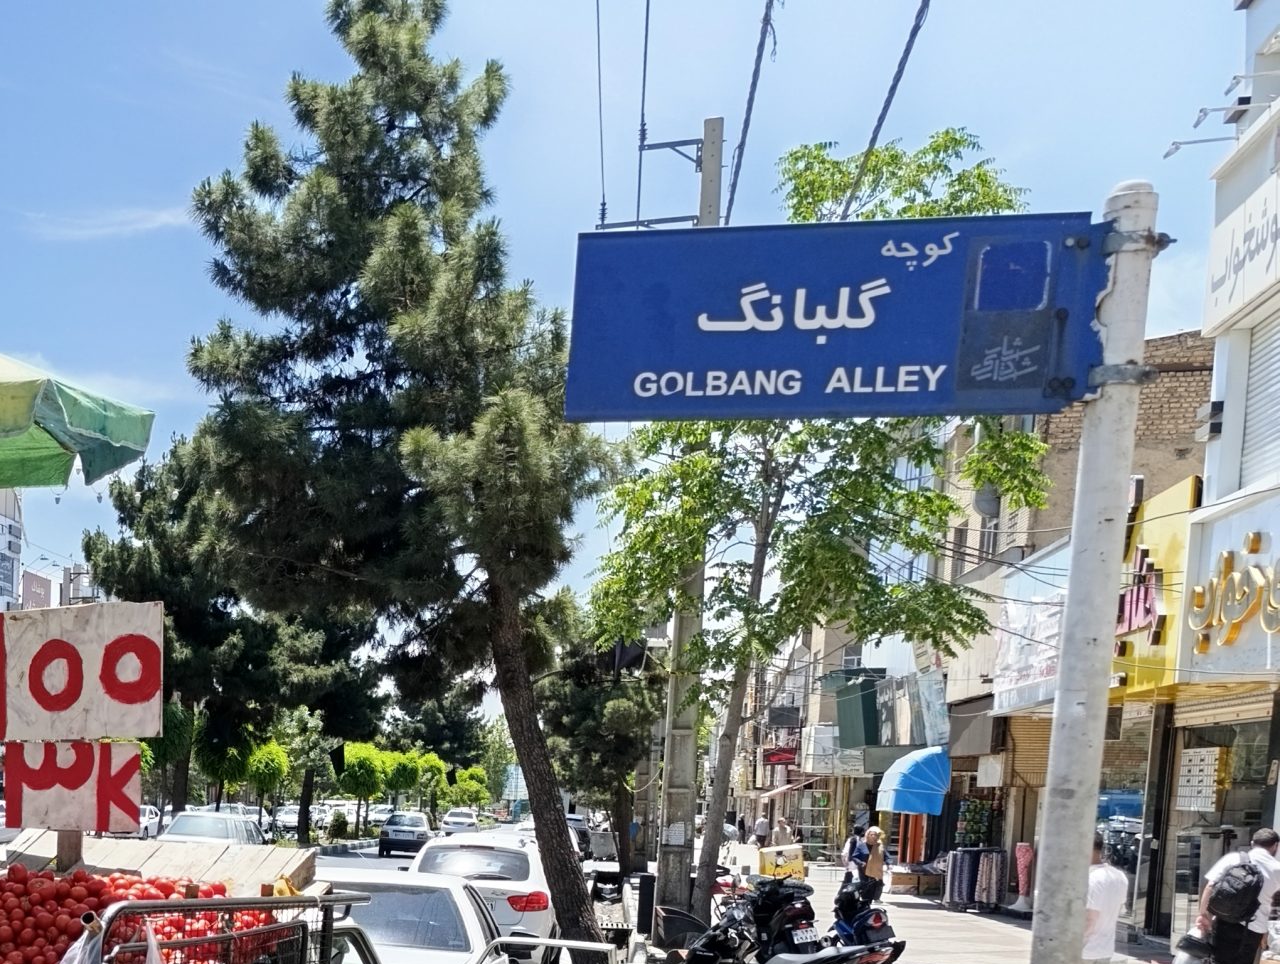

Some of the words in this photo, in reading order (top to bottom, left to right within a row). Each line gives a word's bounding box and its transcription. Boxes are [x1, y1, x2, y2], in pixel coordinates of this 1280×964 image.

[880, 230, 961, 272] کوچه
[696, 277, 891, 345] گلبانگ
[632, 369, 802, 398] GOLBANG
[825, 363, 948, 395] ALLEY
